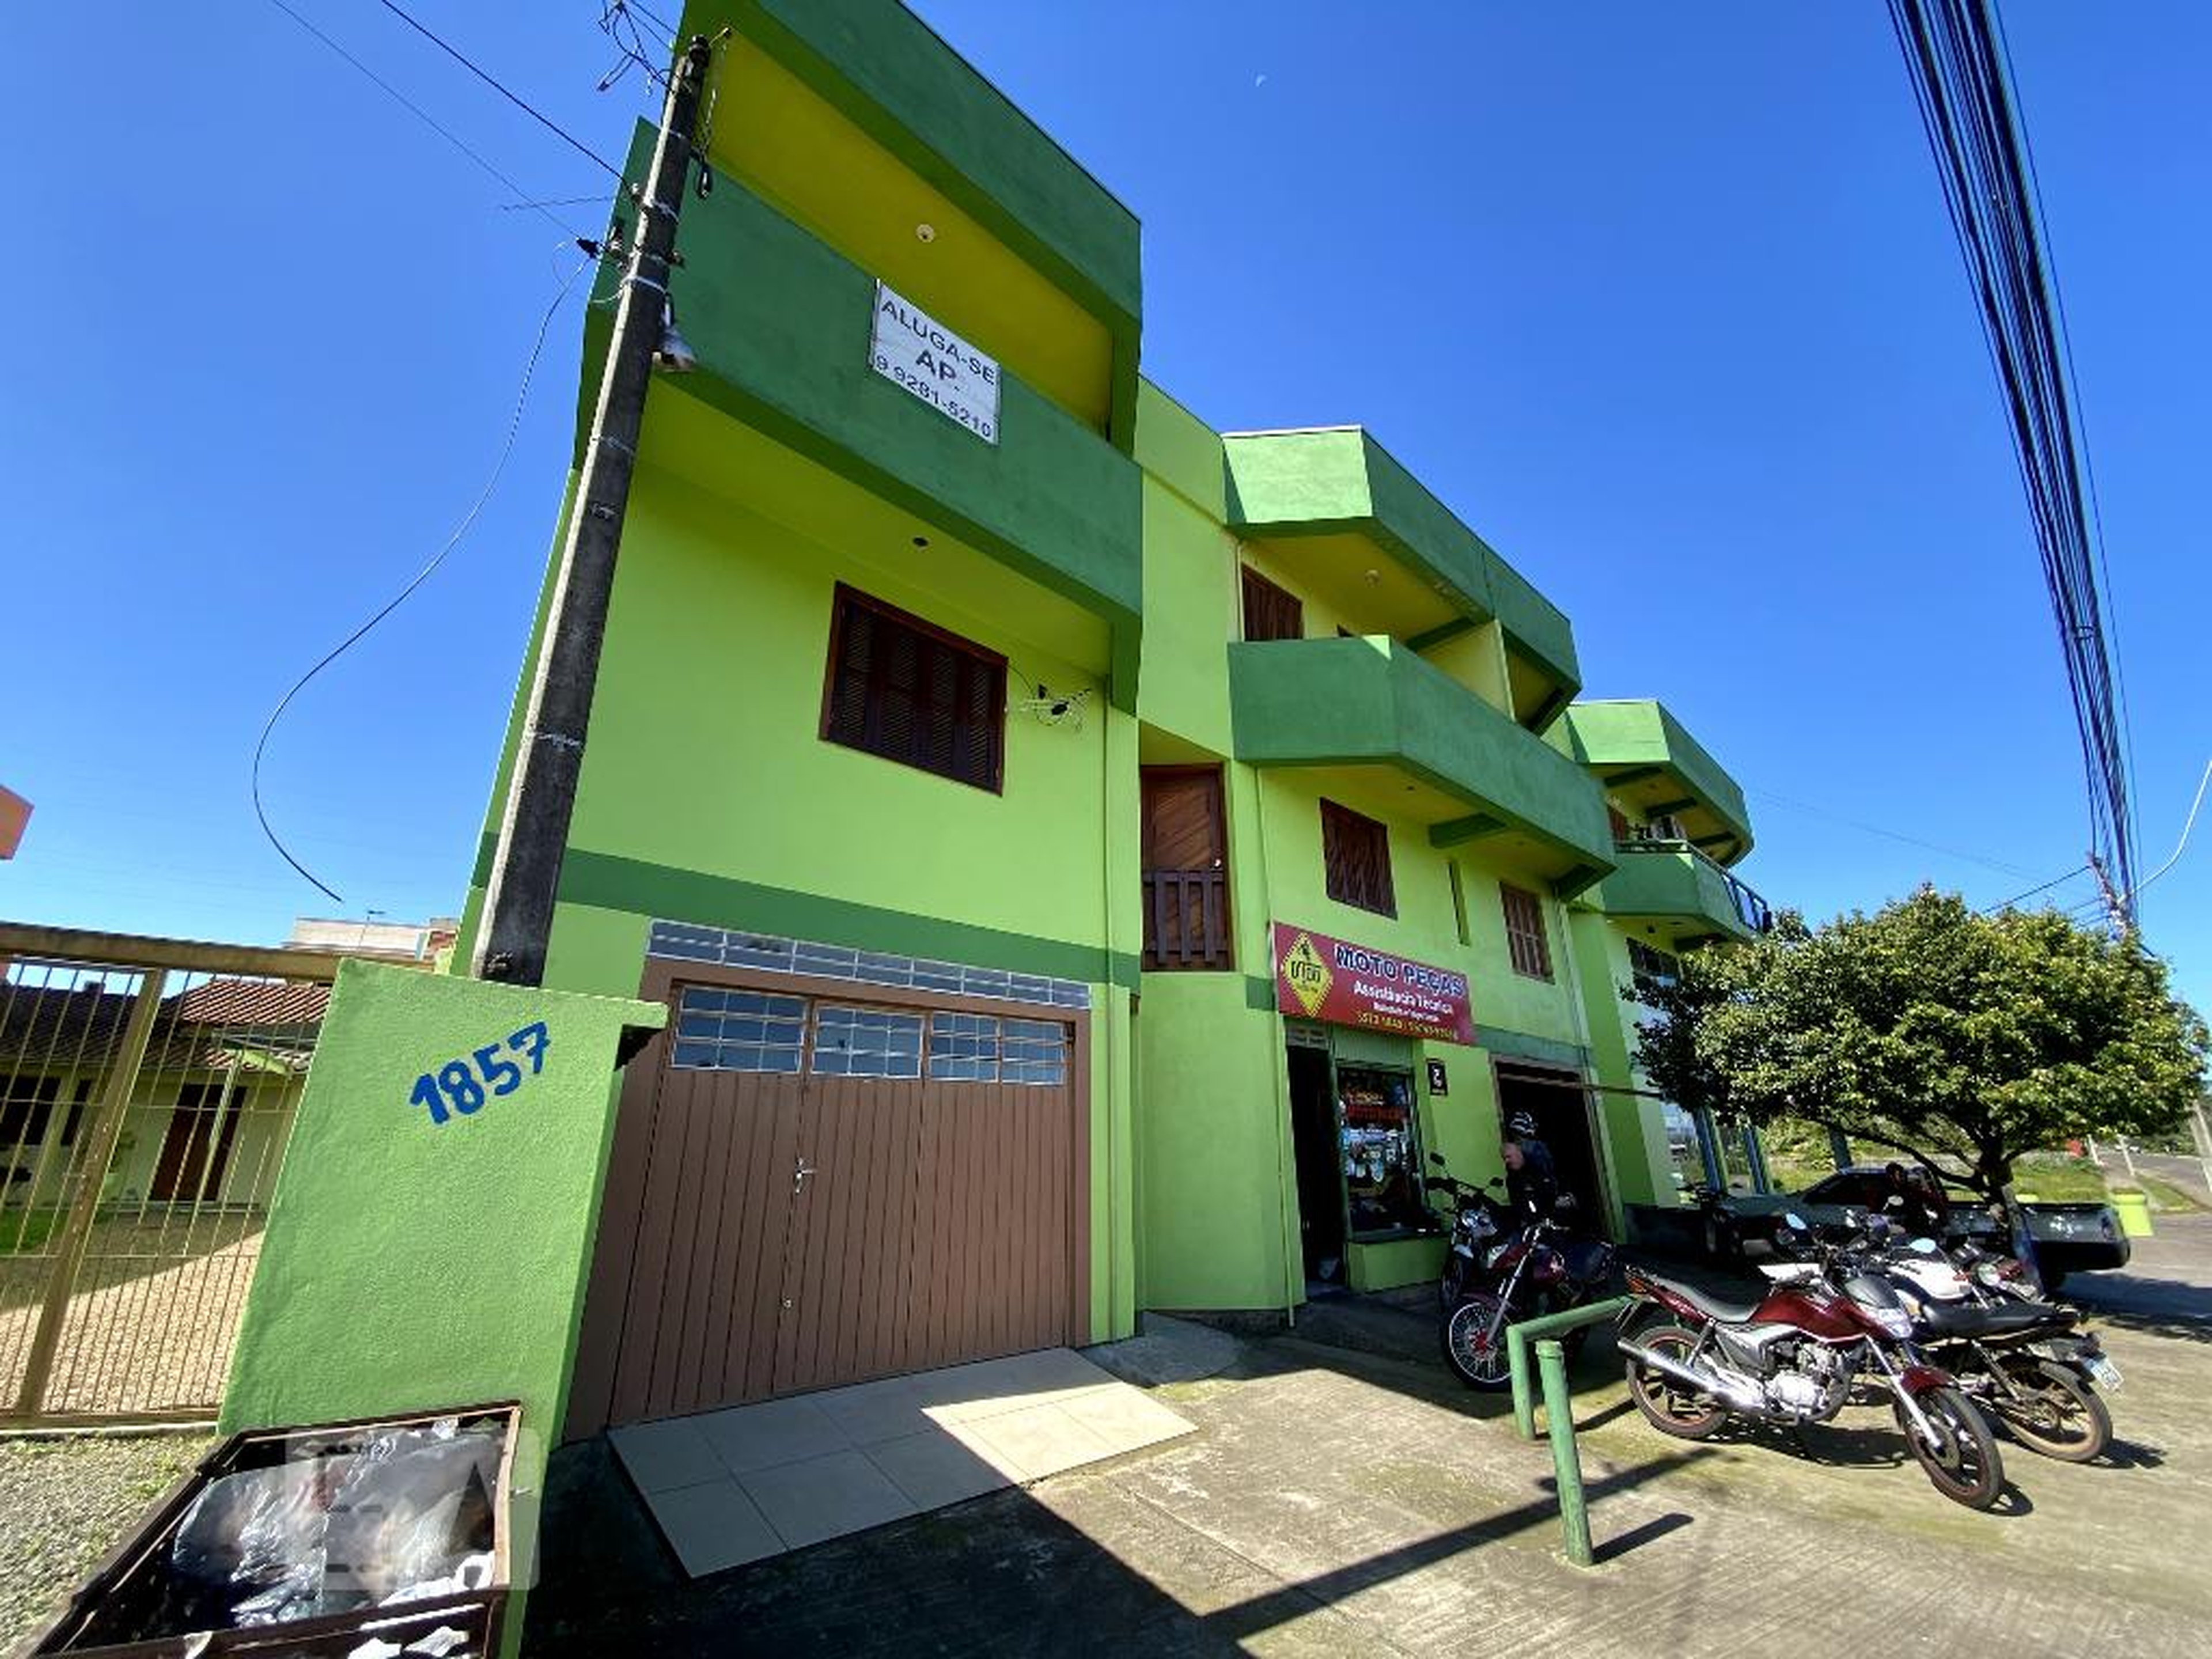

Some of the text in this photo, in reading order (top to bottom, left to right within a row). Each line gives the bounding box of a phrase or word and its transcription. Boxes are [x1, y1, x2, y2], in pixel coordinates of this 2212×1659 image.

[881, 300, 995, 385] ALUGA-SE
[876, 355, 992, 438] 9 9281-5210
[1334, 944, 1399, 982] MOTO
[1401, 961, 1466, 998] PEÇAS
[410, 1021, 551, 1124] 1857
